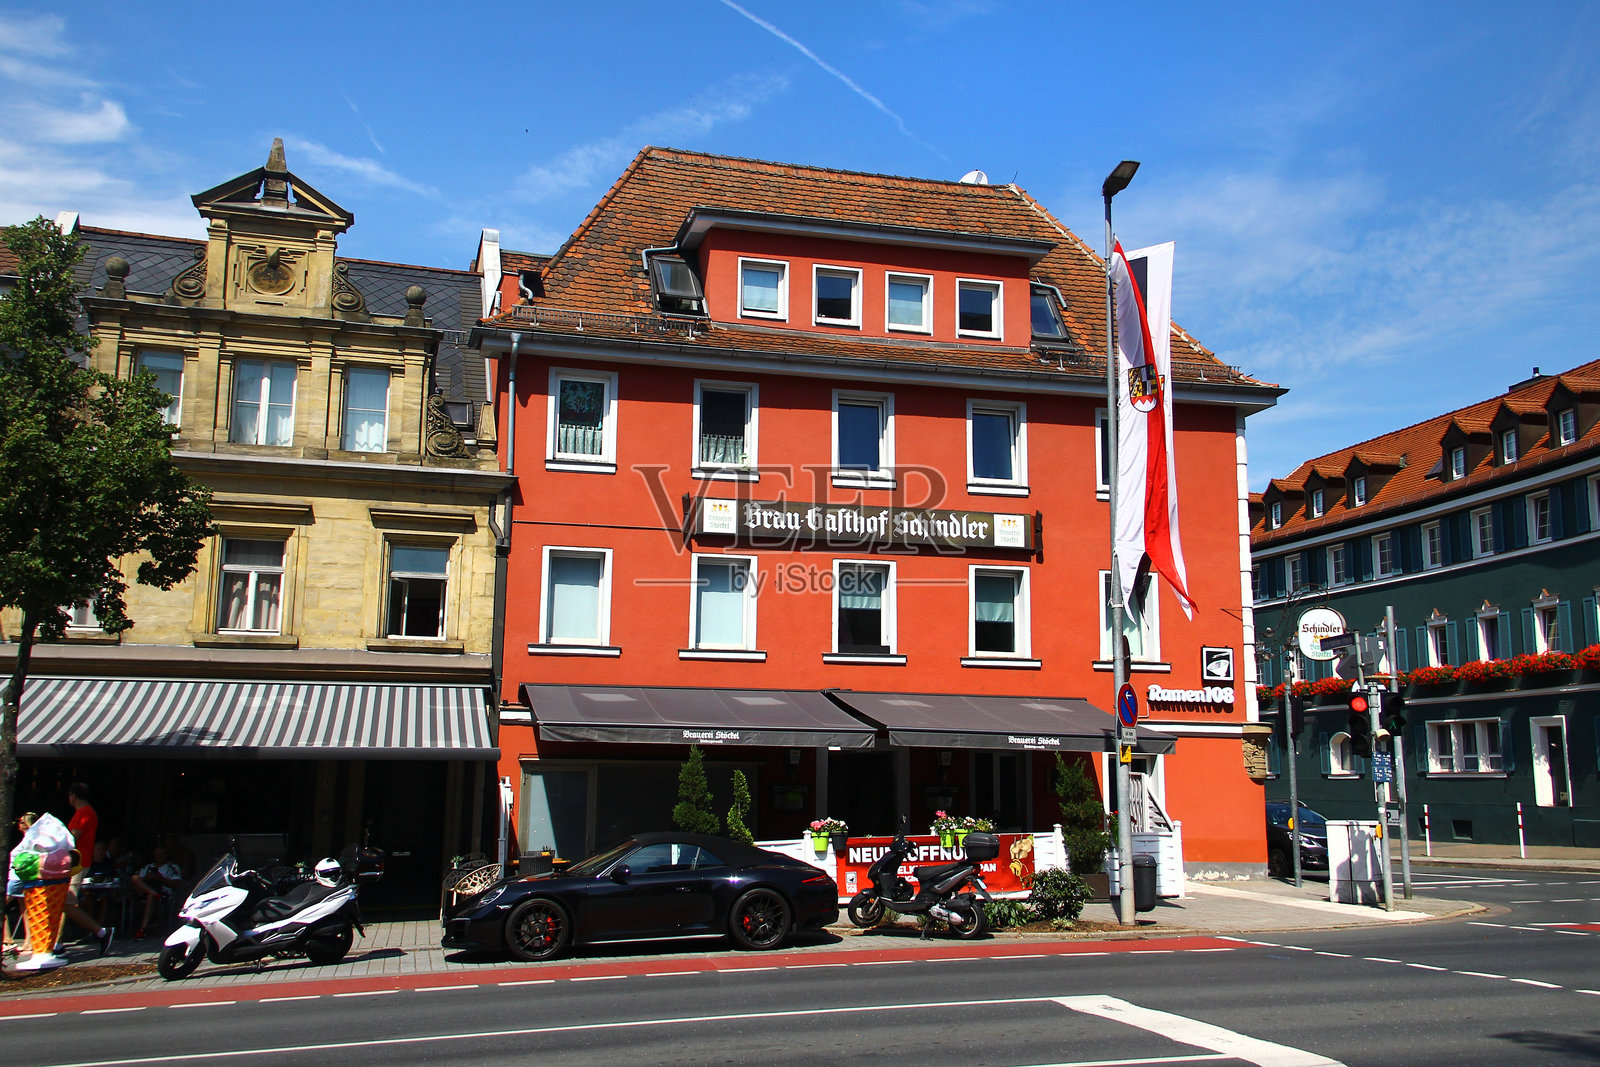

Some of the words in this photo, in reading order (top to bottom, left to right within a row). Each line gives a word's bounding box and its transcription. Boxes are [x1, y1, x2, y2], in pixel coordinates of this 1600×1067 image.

[892, 510, 988, 540] Schindler
[1302, 621, 1340, 633] Schindler
[682, 729, 714, 739] Brauerei
[715, 730, 740, 740] Stöckel
[1007, 735, 1036, 744] Brauerei
